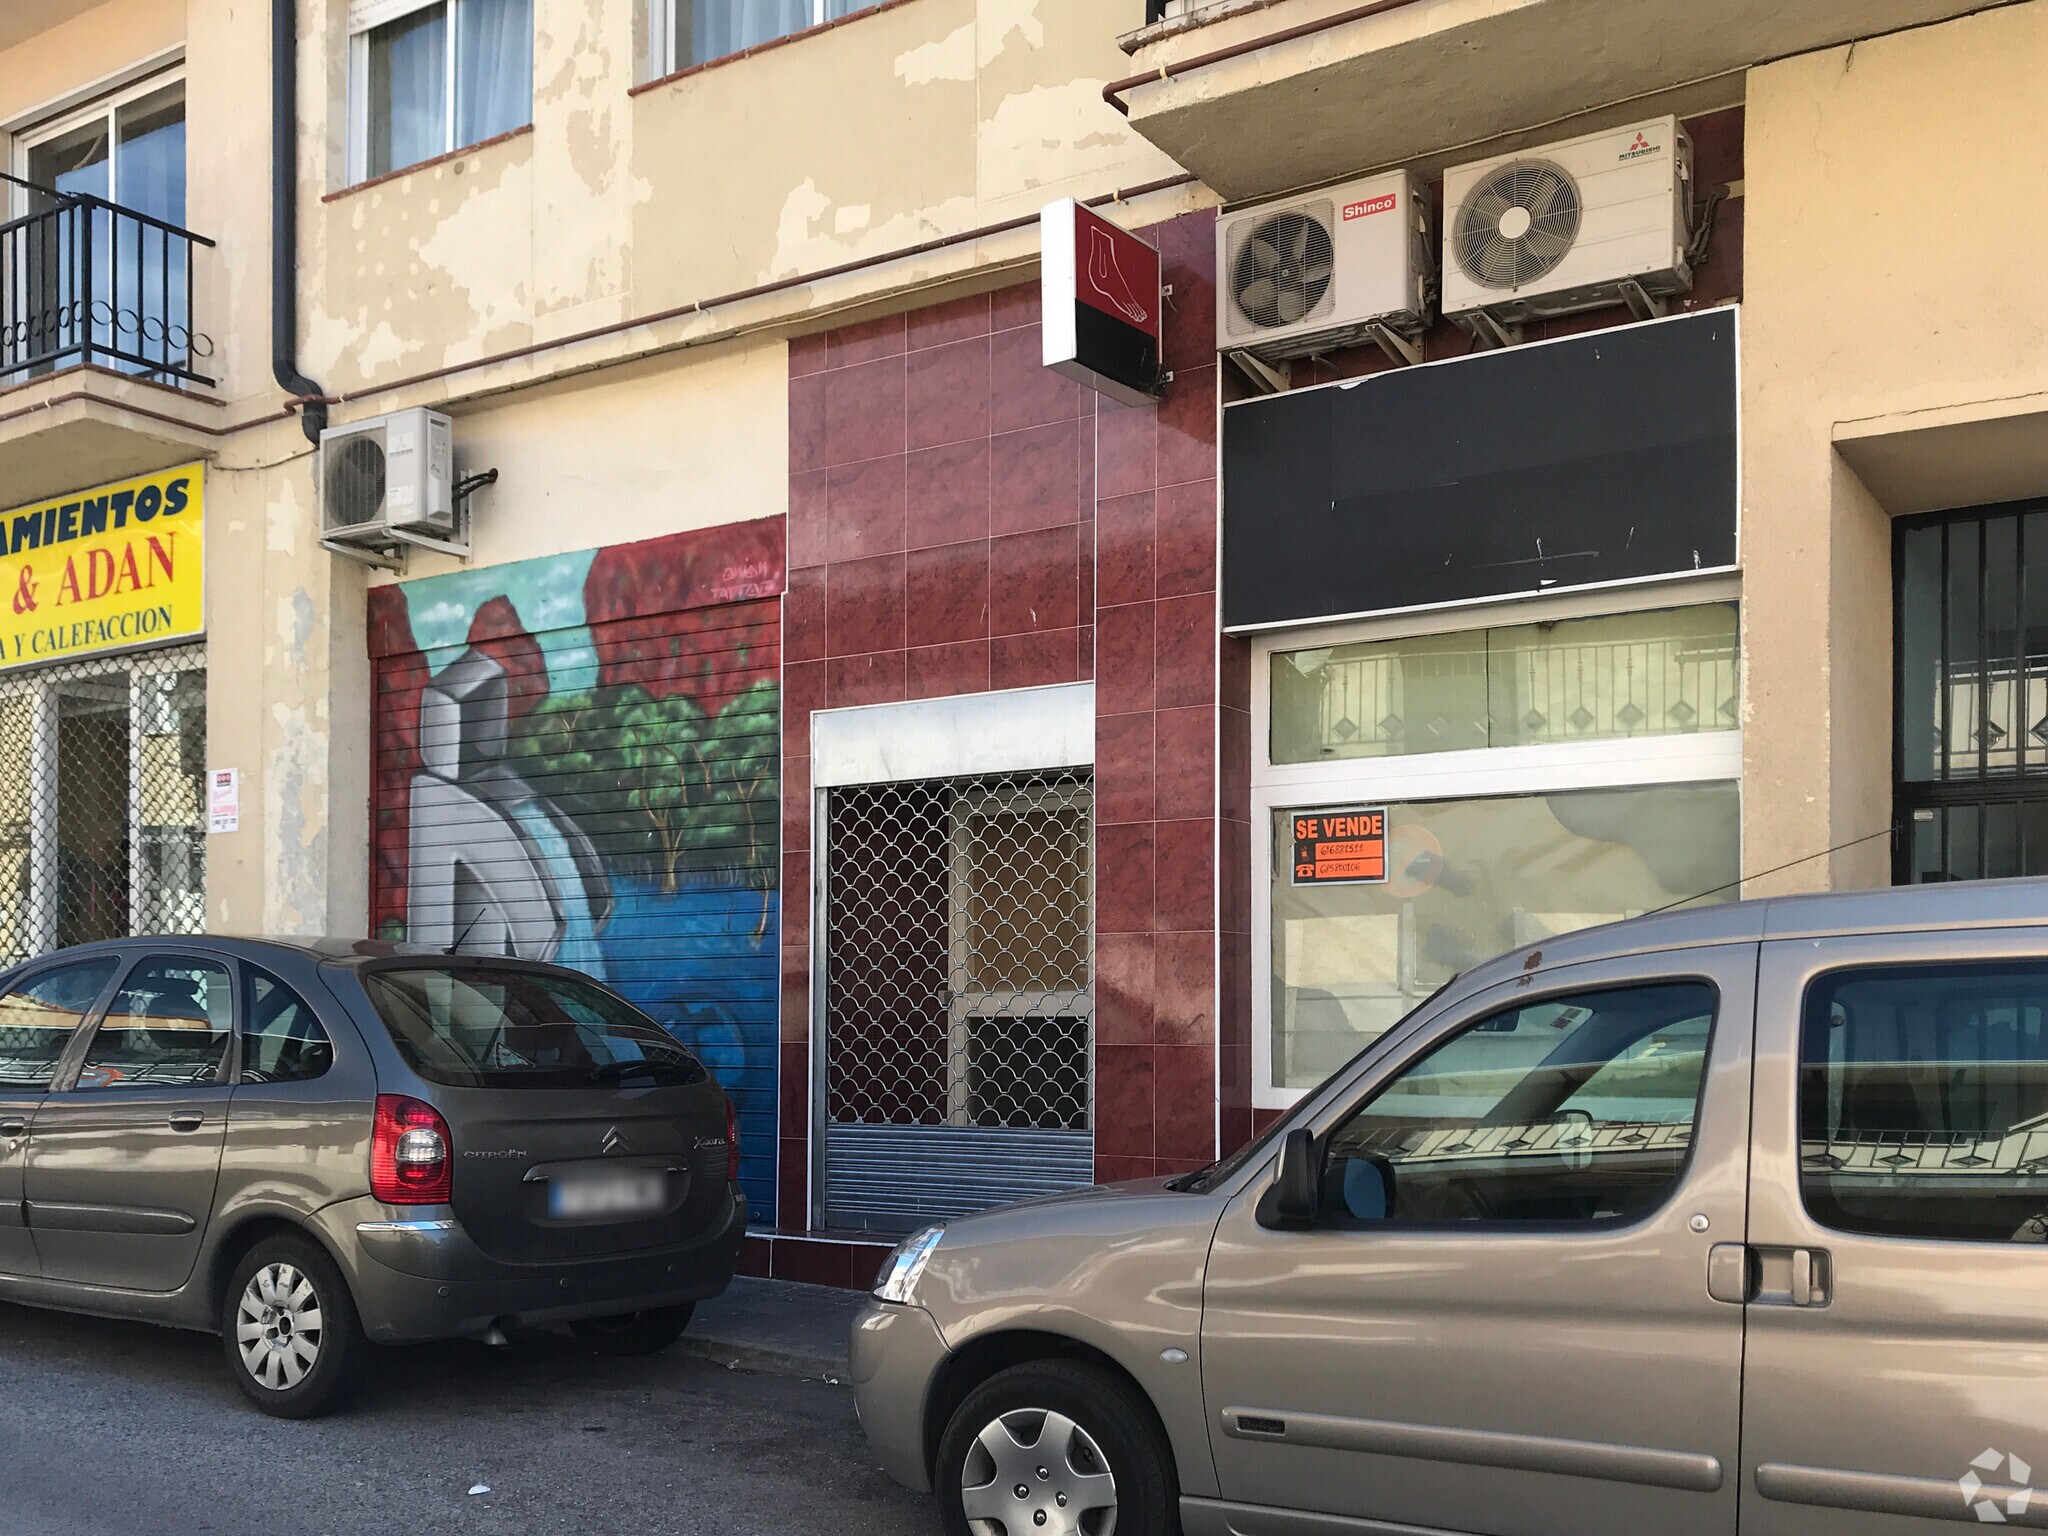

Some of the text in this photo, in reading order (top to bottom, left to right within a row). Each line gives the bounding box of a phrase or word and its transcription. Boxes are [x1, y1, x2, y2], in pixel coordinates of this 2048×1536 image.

[1344, 199, 1392, 218] Shinco
[12, 531, 177, 615] & ADAN
[13, 633, 25, 657] Y
[32, 604, 173, 654] CALEFACCION
[1296, 815, 1383, 839] SE VENDE
